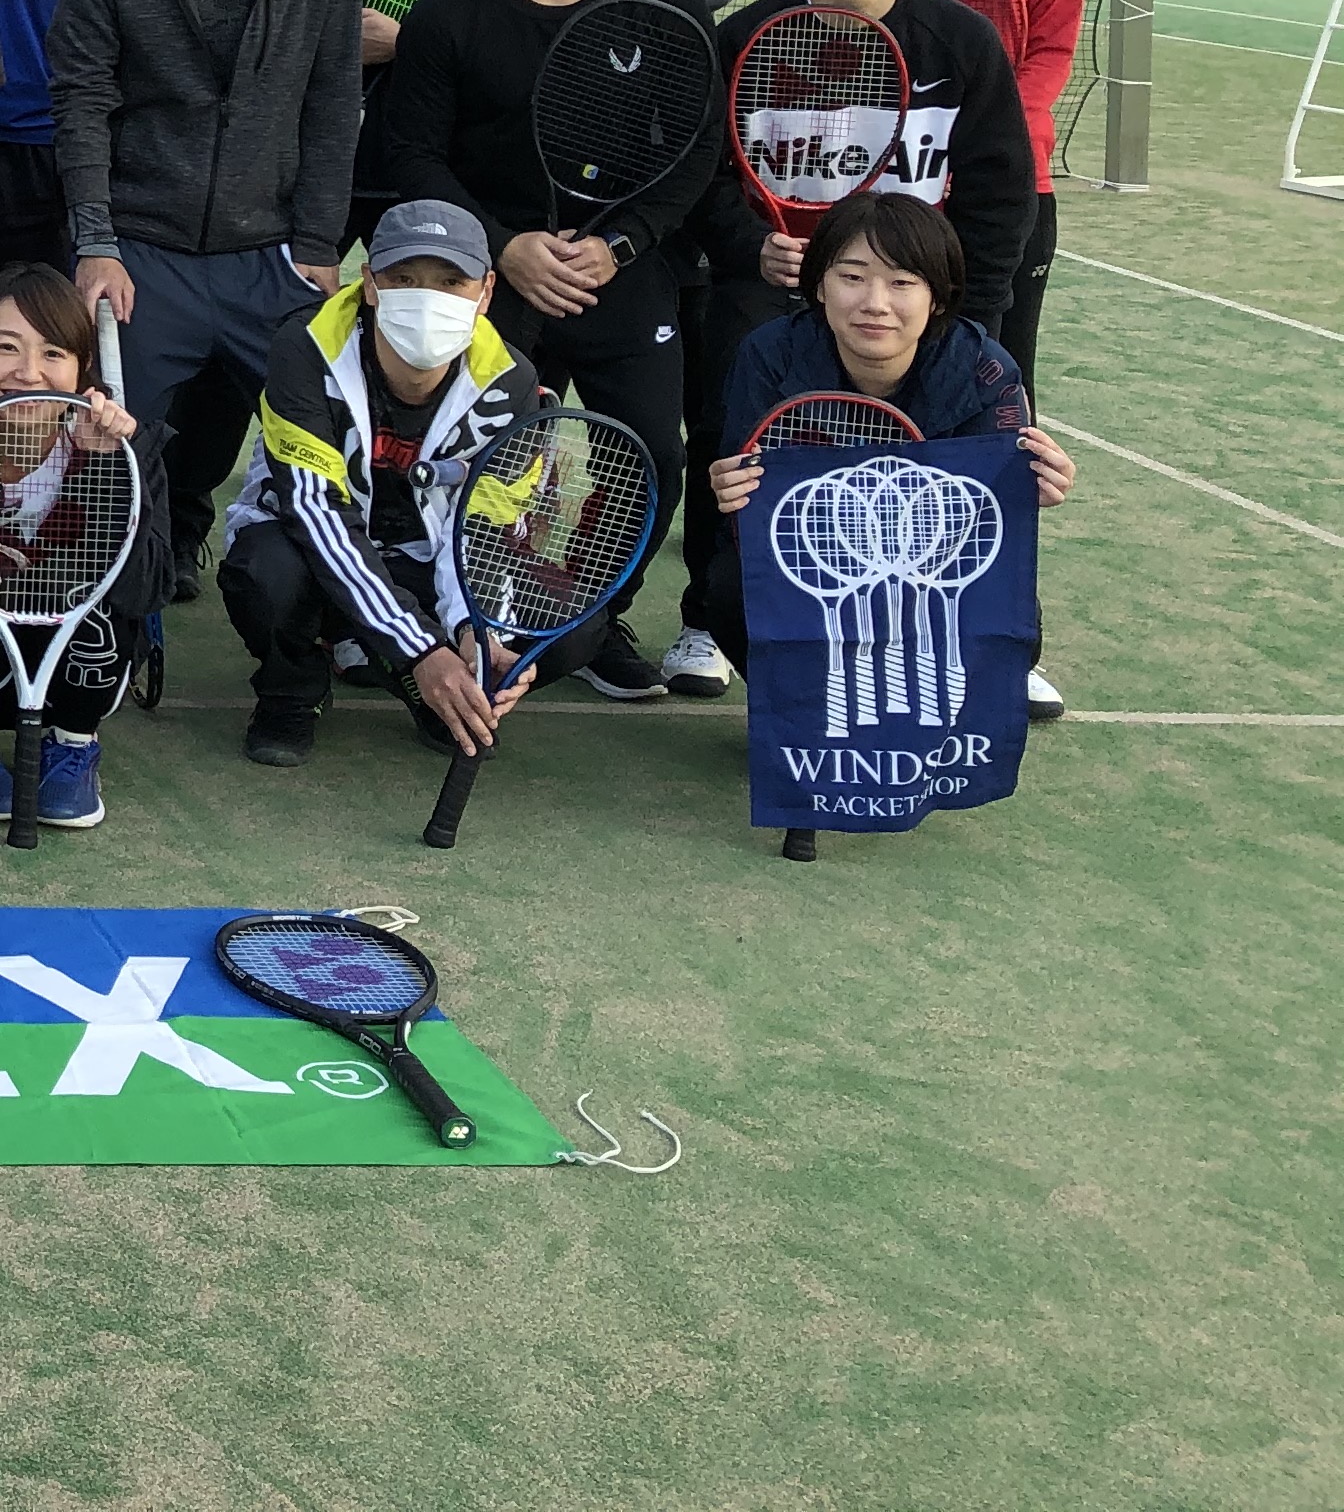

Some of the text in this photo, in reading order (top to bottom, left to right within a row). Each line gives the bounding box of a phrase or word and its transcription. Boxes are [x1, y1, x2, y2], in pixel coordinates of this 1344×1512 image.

[749, 133, 952, 183] Nike Air
[779, 733, 994, 786] WINDOR
[812, 776, 969, 817] RACKET OP
